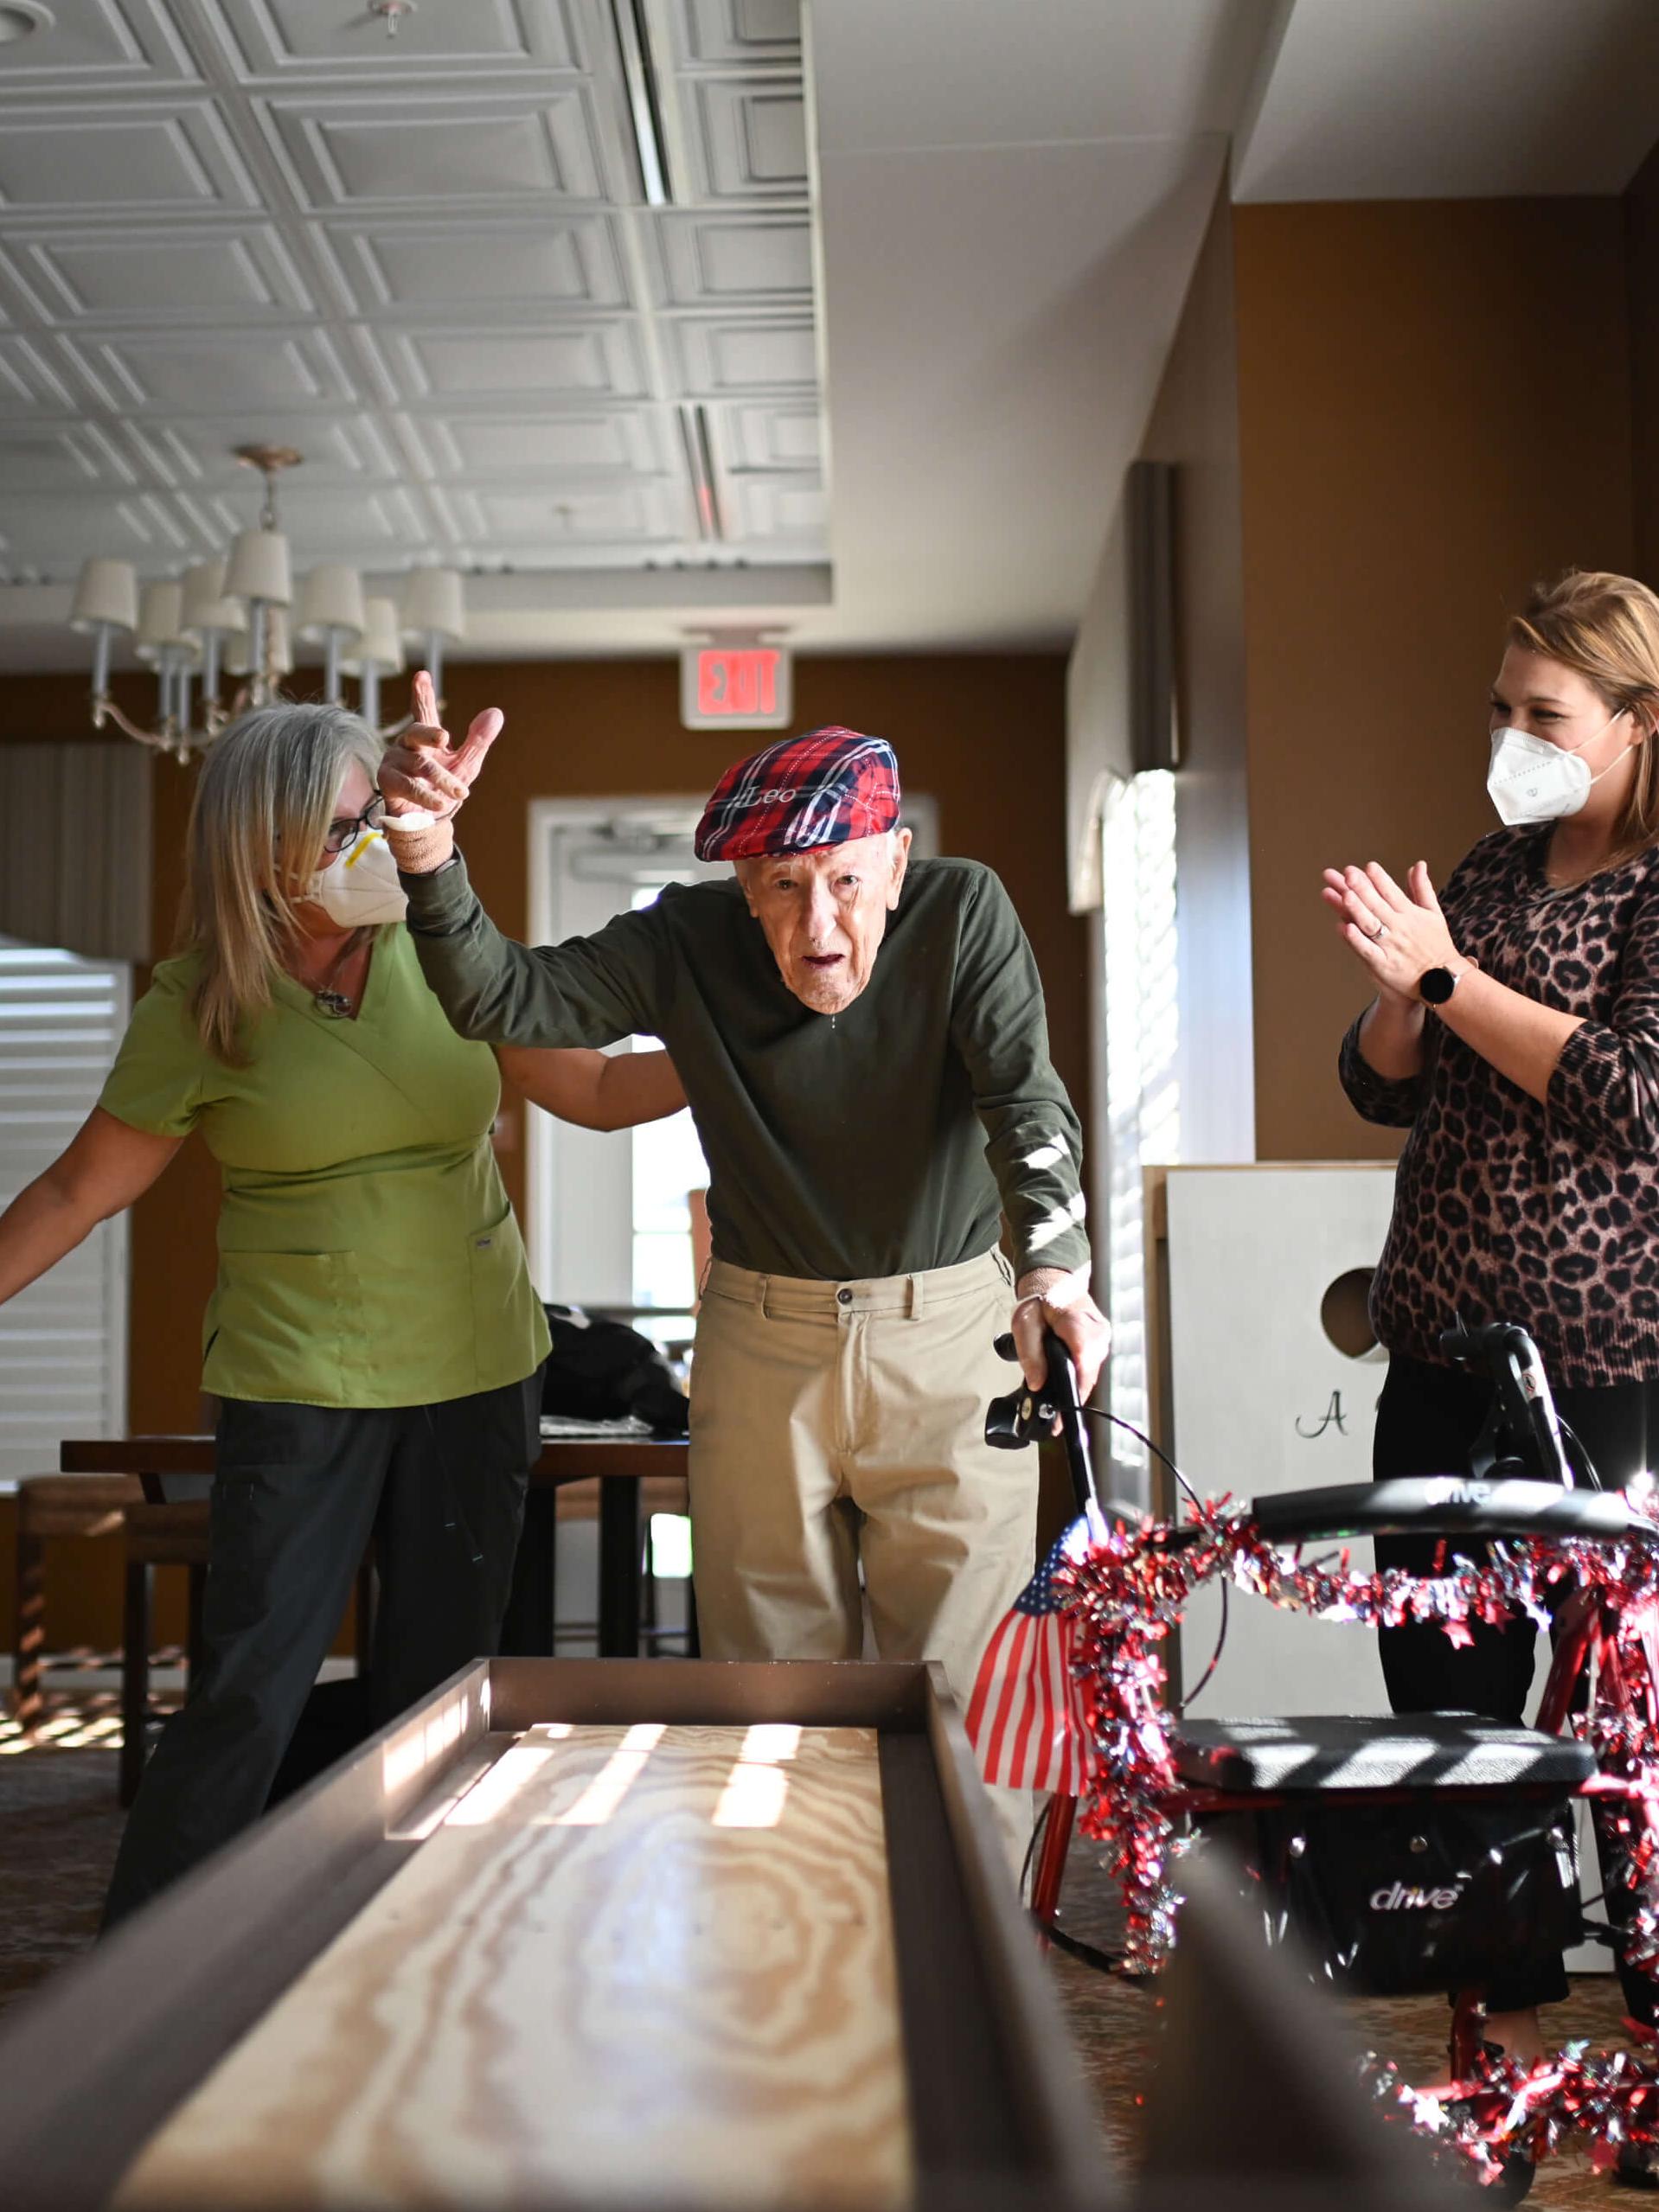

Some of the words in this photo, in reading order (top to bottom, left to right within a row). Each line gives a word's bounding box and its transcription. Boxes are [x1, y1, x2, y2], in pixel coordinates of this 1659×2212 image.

[698, 649, 780, 715] EXIT
[734, 785, 796, 809] Leo
[1295, 1389, 1349, 1439] A
[1370, 1881, 1458, 1910] drive
